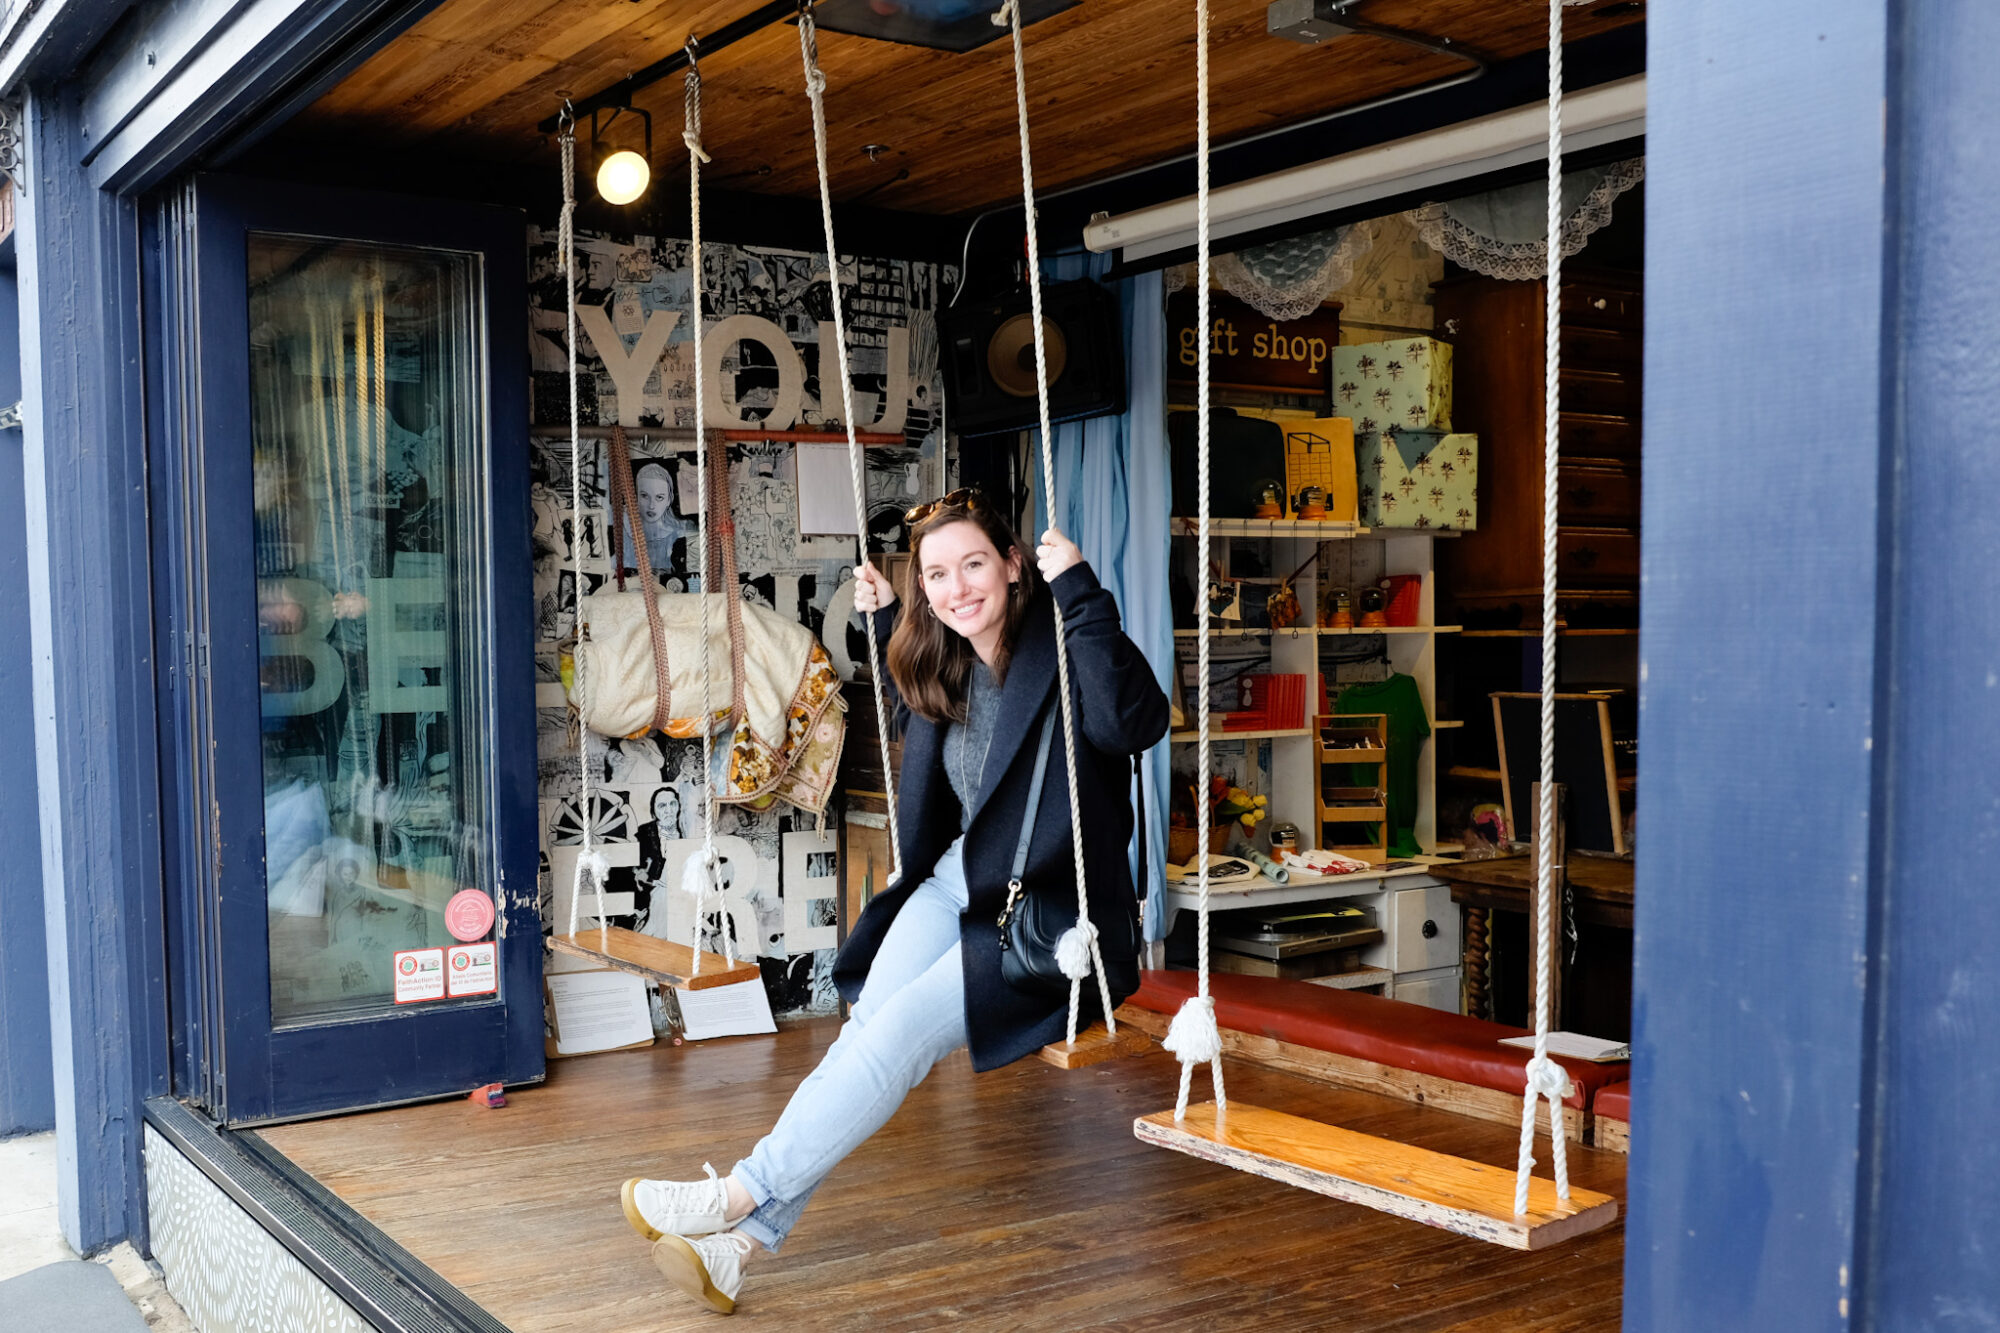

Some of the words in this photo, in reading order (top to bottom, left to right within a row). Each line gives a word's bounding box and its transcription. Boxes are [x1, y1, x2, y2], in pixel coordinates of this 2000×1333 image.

[574, 303, 909, 432] YOU
[1179, 318, 1239, 366] gft
[1253, 323, 1327, 374] shop
